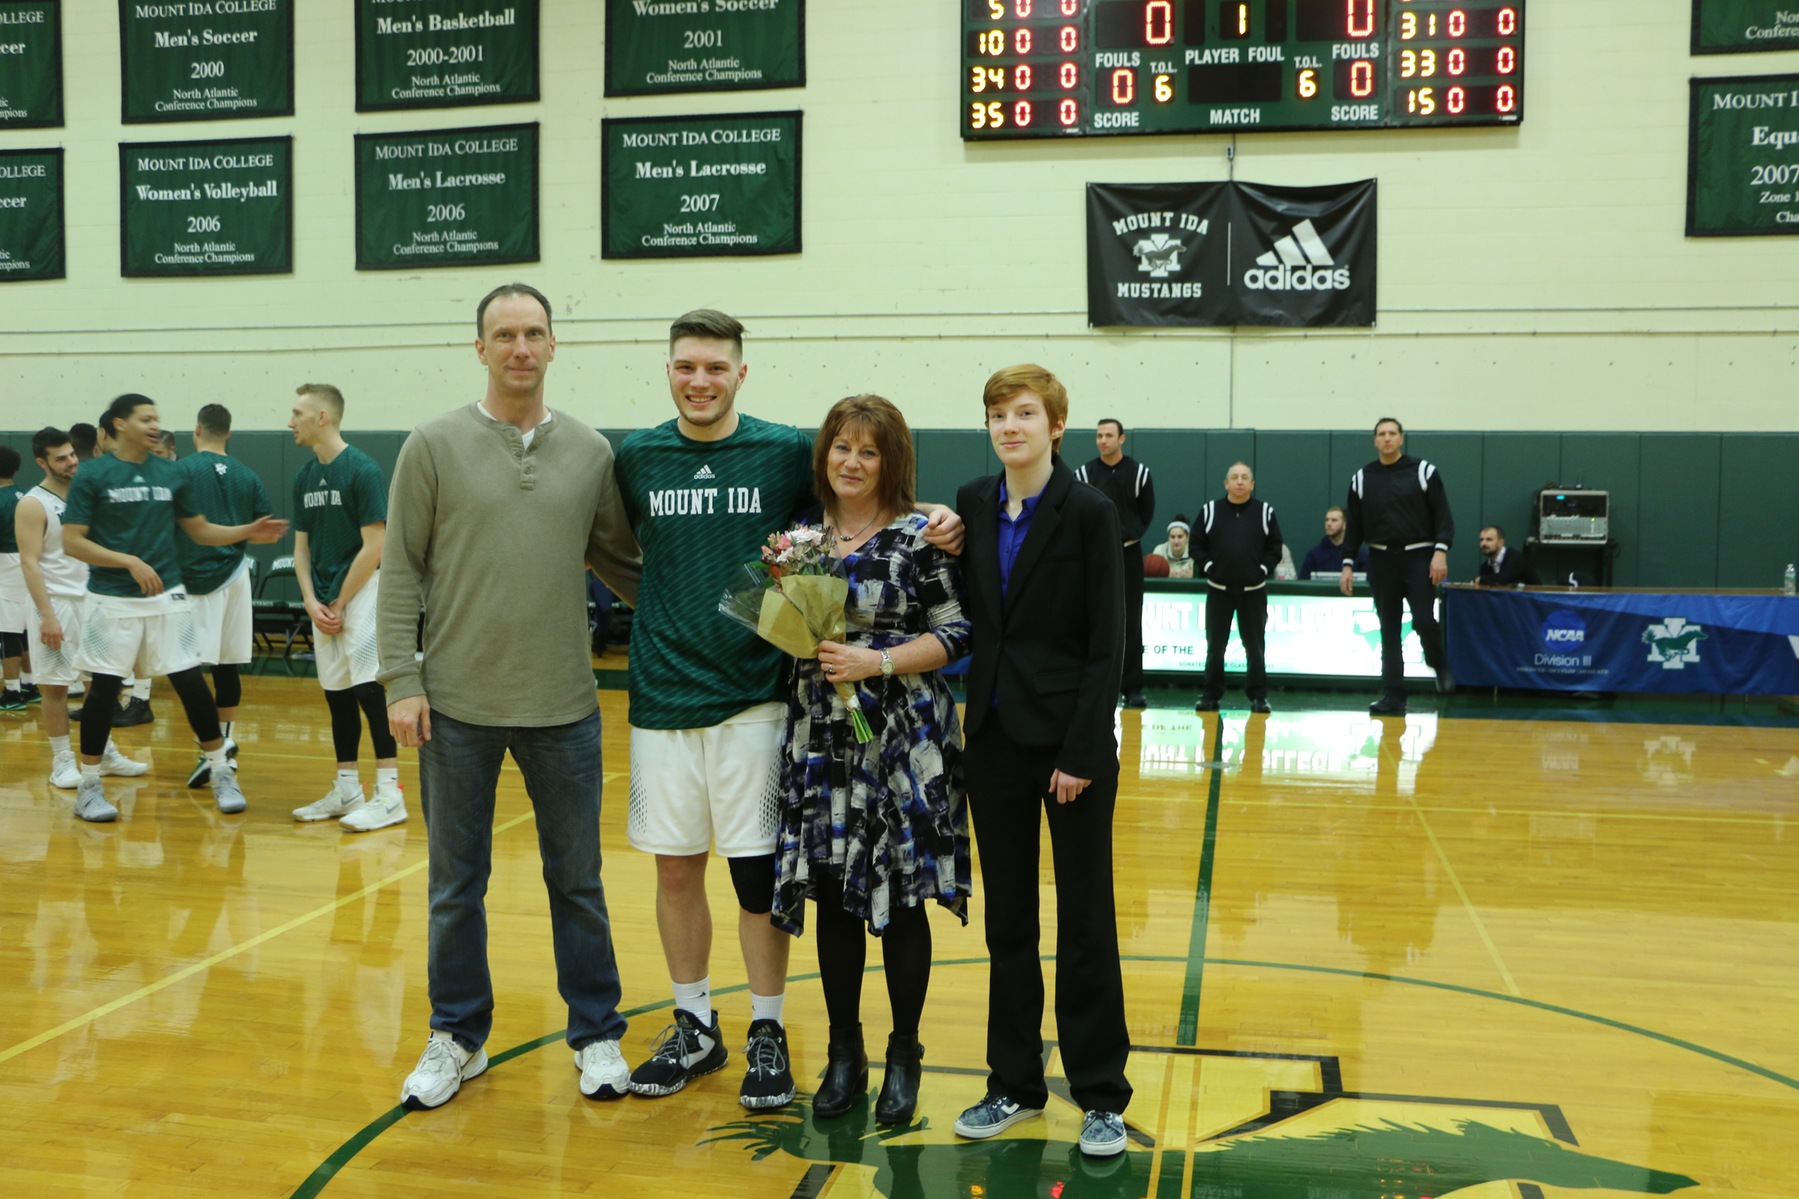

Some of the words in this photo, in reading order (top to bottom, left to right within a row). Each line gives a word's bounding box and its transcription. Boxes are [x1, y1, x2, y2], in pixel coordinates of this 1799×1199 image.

[0, 11, 44, 23] LLEGE
[135, 5, 186, 18] MOUNT
[189, 2, 212, 16] IDA
[215, 0, 276, 14] COLLEGE
[633, 0, 709, 16] Women's
[715, 0, 779, 12] Soccer
[988, 0, 1004, 20] 5
[377, 15, 423, 34] Men's
[429, 8, 515, 31] Basketball
[1146, 0, 1171, 45] 0
[1239, 4, 1246, 35] 1
[1402, 11, 1436, 40] 31
[1449, 10, 1465, 36] 0
[1499, 8, 1514, 35] 0
[154, 29, 199, 48] Men's
[203, 29, 258, 45] Soccer
[684, 30, 723, 48] 2001
[980, 29, 1004, 56] 10
[1015, 28, 1031, 54] 0
[1060, 26, 1077, 52] 0
[406, 45, 484, 66] 2000-2001
[1096, 52, 1140, 68] FOULS
[1185, 48, 1239, 65] PLAYER
[1248, 47, 1285, 62] FOUL
[1332, 43, 1379, 59] FOULS
[191, 61, 224, 78] 2000
[668, 60, 697, 71] North
[700, 57, 740, 69] Atlantic
[1402, 49, 1435, 78] 33
[1448, 49, 1464, 75] 0
[1498, 47, 1514, 73] 0
[411, 75, 440, 86] North
[443, 72, 480, 84] Atlantic
[646, 72, 702, 84] Conference
[705, 68, 762, 82] Champions
[972, 66, 1004, 93] 34
[1015, 65, 1031, 90] 0
[1061, 63, 1076, 89] 0
[1299, 69, 1316, 98] 6
[1351, 61, 1372, 96] 0
[173, 88, 201, 99] North
[203, 86, 238, 98] Atlantic
[392, 86, 444, 99] Conference
[447, 83, 501, 96] Champions
[1113, 69, 1133, 104] 0
[1155, 75, 1172, 102] 6
[155, 100, 205, 111] Conference
[207, 97, 257, 110] Champions
[1409, 88, 1435, 115] 15
[1448, 87, 1464, 113] 0
[1498, 86, 1513, 112] 0
[1713, 92, 1788, 110] MOUNT
[972, 102, 1004, 129] 35
[1015, 101, 1031, 127] 0
[1061, 100, 1076, 125] 0
[1094, 112, 1140, 129] SCORE
[1210, 109, 1260, 125] MATCH
[1331, 105, 1378, 122] SCORE
[623, 133, 679, 148] MOUNT
[681, 131, 709, 146] IDA
[711, 128, 781, 144] COLLEGE
[375, 144, 425, 160] MOUNT
[428, 143, 452, 157] IDA
[455, 138, 518, 155] COLLEGE
[138, 158, 186, 171] MOUNT
[189, 157, 211, 170] IDA
[214, 154, 273, 168] COLLEGE
[635, 160, 684, 179] Men's
[690, 160, 766, 177] Lacrosse
[388, 171, 432, 190] Men's
[436, 171, 506, 188] Lacrosse
[136, 183, 201, 200] Women's
[204, 180, 277, 202] Volleyball
[1760, 191, 1791, 204] Zone
[680, 194, 720, 213] 2007
[427, 204, 466, 222] 2006
[187, 216, 221, 233] 2006
[663, 224, 693, 235] North
[696, 222, 736, 233] Atlantic
[1112, 211, 1174, 236] MOUNT
[1179, 213, 1209, 235] IDA
[413, 231, 439, 243] North
[441, 229, 477, 241] Atlantic
[641, 235, 697, 247] Conference
[699, 233, 758, 246] Champions
[174, 242, 200, 253] North
[202, 241, 236, 252] Atlantic
[393, 244, 444, 255] Conference
[447, 241, 499, 253] Champions
[155, 253, 203, 264] Conference
[204, 252, 255, 264] Champions
[1244, 264, 1350, 290] adidas
[1117, 282, 1202, 298] MUSTANGS
[649, 488, 718, 517] MOUNT
[728, 487, 761, 514] IDA
[1142, 602, 1193, 631] UNT
[1545, 629, 1585, 642] NCAA
[1153, 645, 1168, 654] OF
[1172, 645, 1194, 655] THE
[1534, 653, 1579, 667] Division
